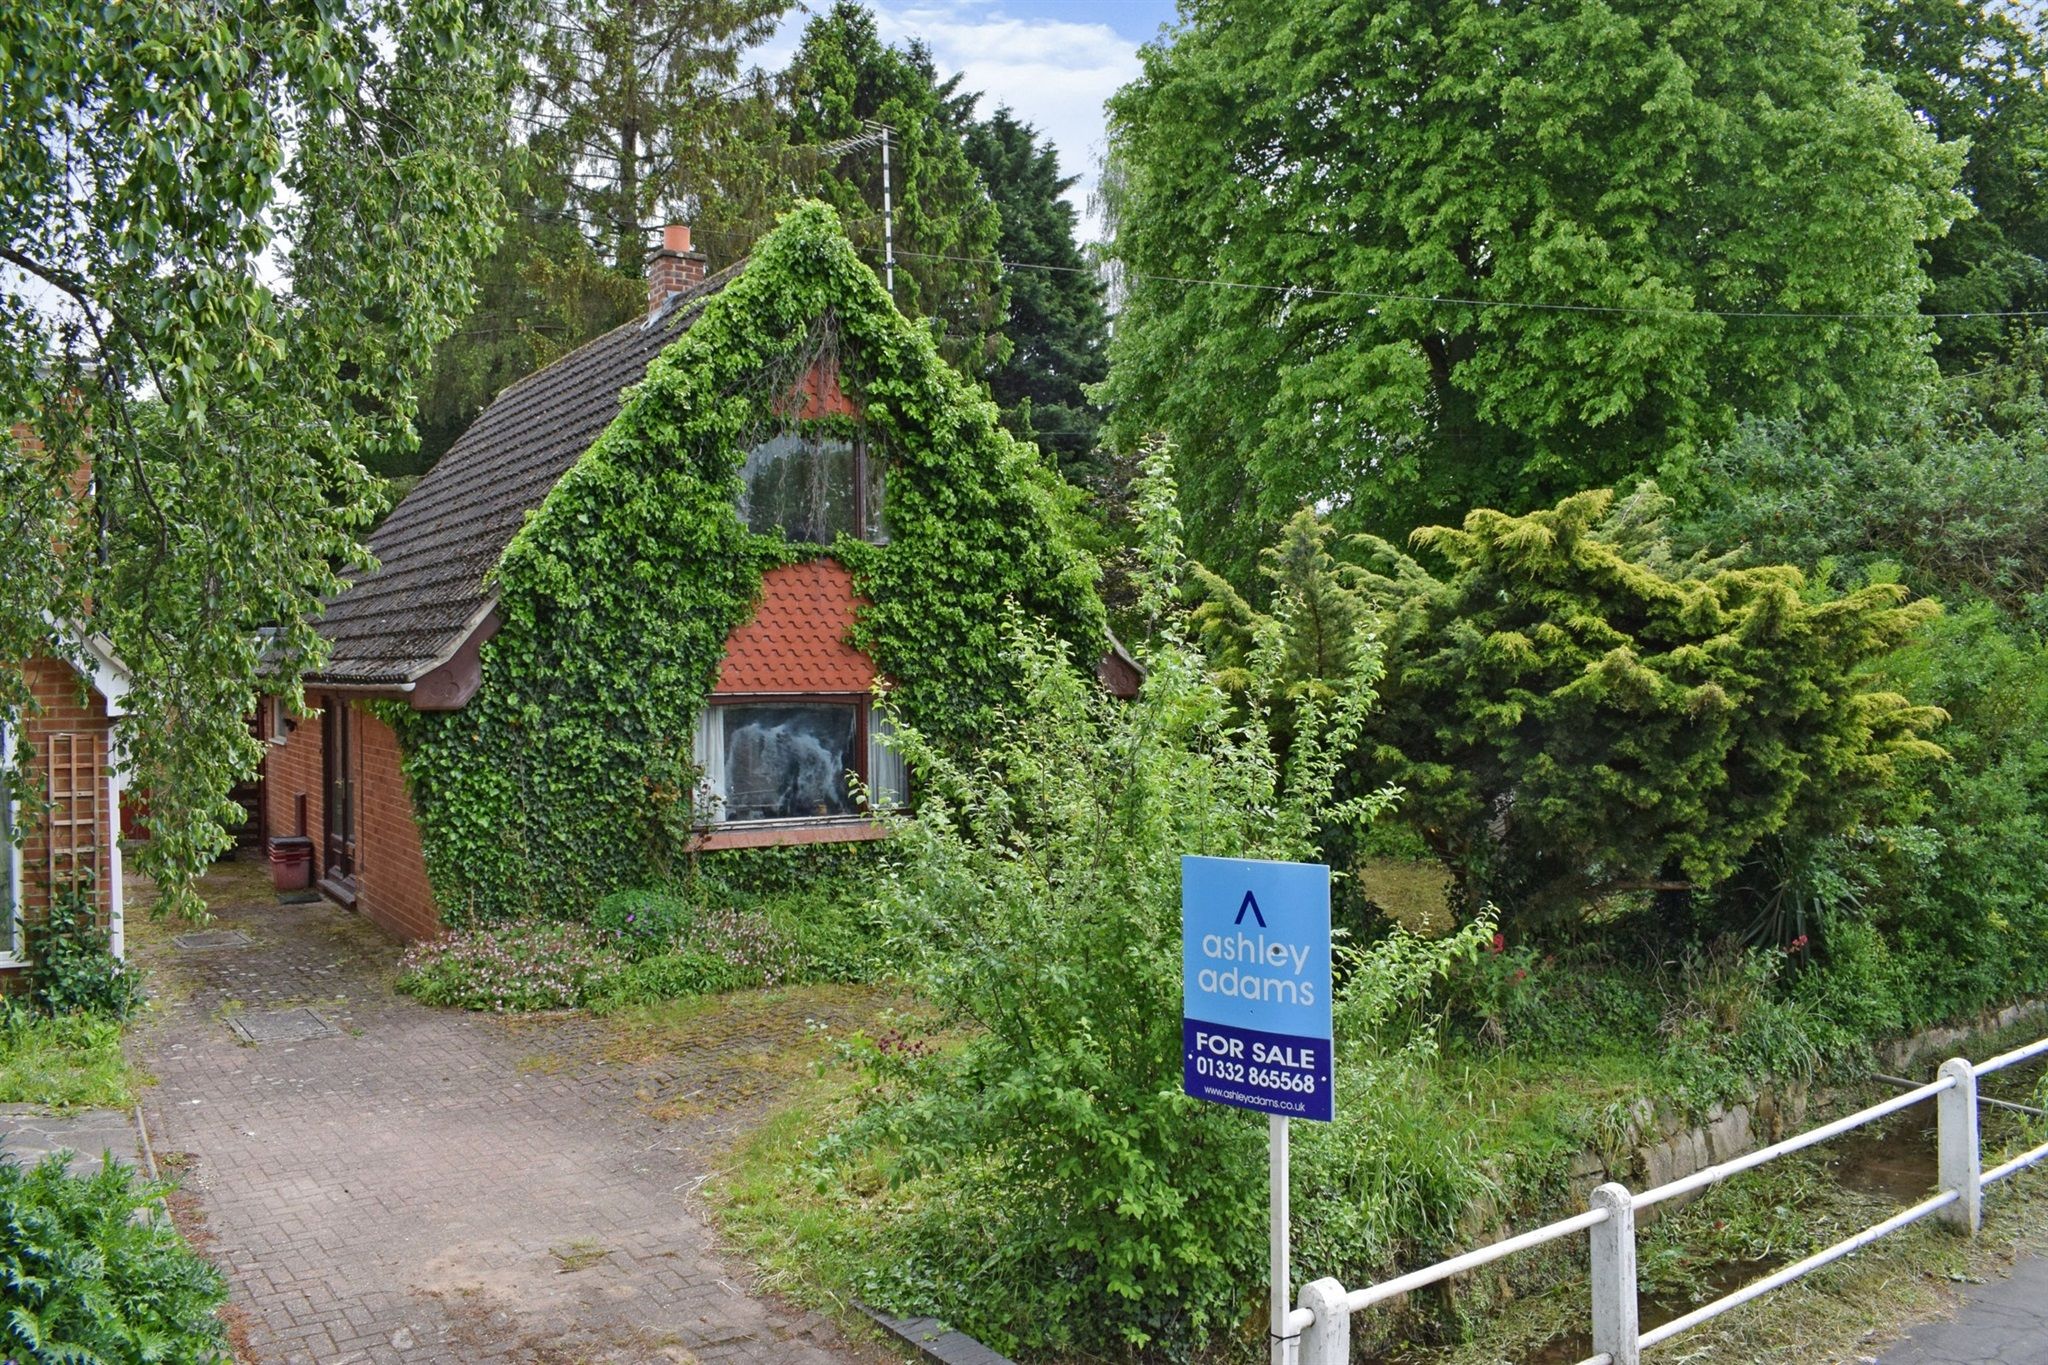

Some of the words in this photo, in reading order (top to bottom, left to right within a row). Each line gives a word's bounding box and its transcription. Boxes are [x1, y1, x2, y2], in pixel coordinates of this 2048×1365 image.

[1202, 931, 1310, 976] ashley
[1198, 966, 1315, 1006] adams
[1196, 1031, 1244, 1060] FOR
[1252, 1042, 1315, 1070] SALE
[1196, 1055, 1245, 1083] 01332
[1248, 1066, 1315, 1094] 865568
[1203, 1085, 1306, 1112] www.ashleyadams.co.uk
